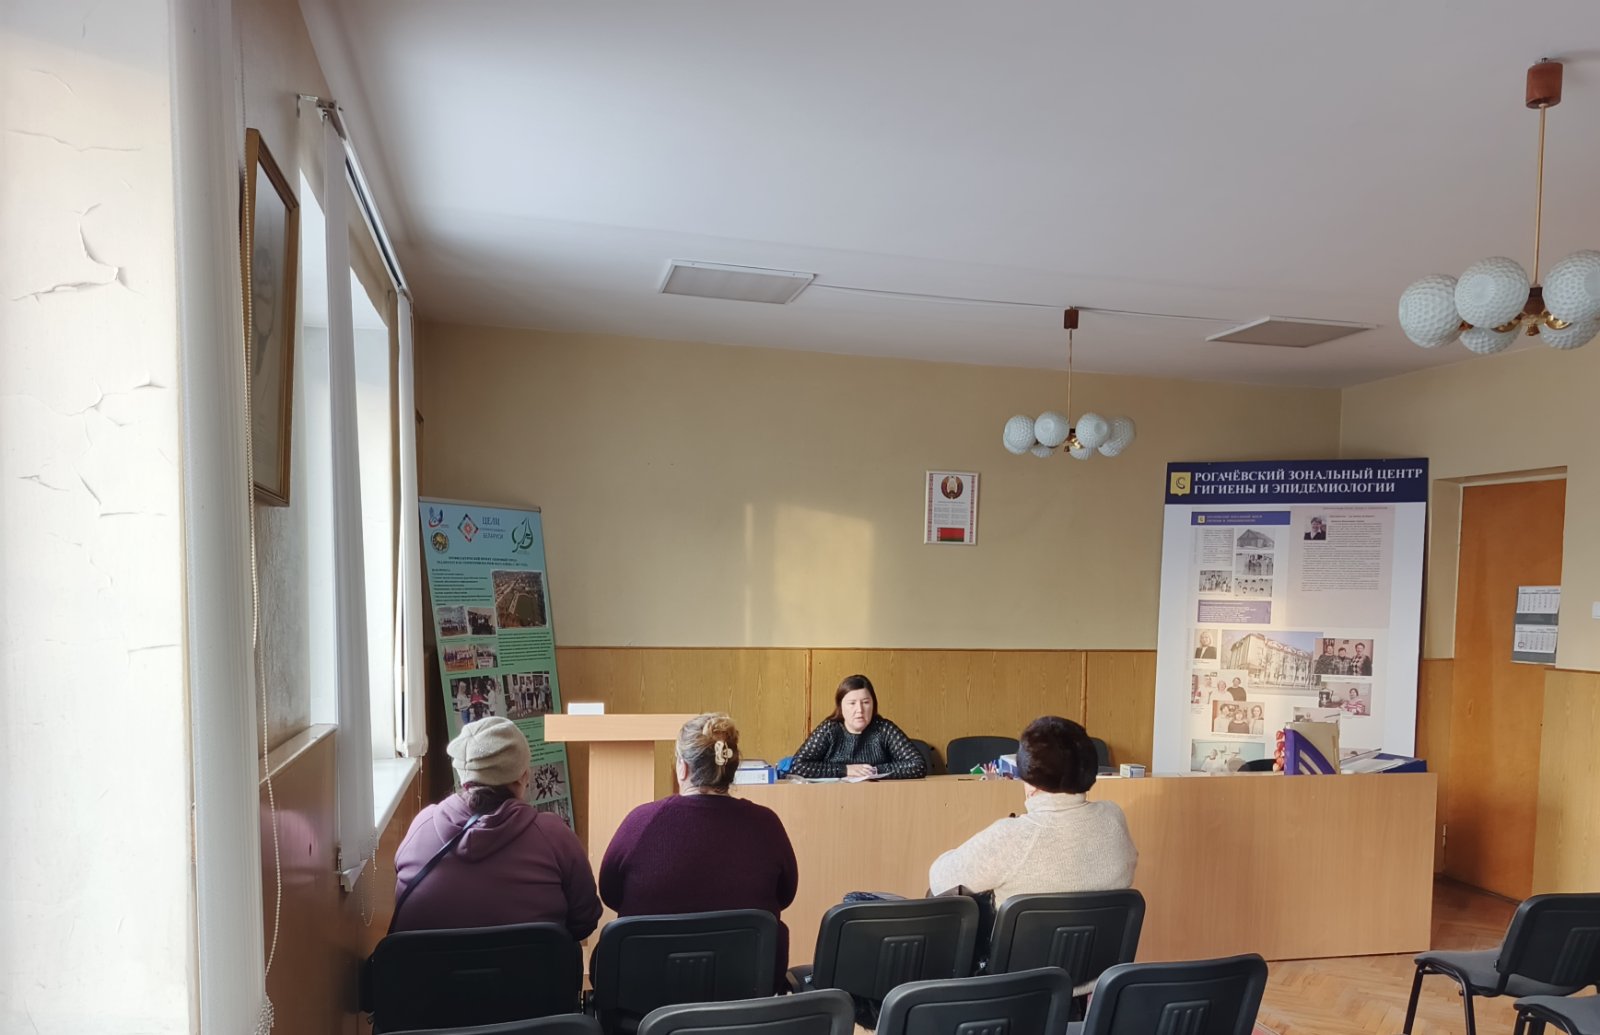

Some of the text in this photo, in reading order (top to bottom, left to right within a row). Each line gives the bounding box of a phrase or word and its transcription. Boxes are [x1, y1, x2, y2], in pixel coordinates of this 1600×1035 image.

[1194, 467, 1423, 482] РОГАЧЁВСКИЙ ЗОНАЛЬНЫЙ ЦЕНТР
[1194, 482, 1395, 495] ГИГИЕНЫ И ЭПИДЕМИОЛОГИИ
